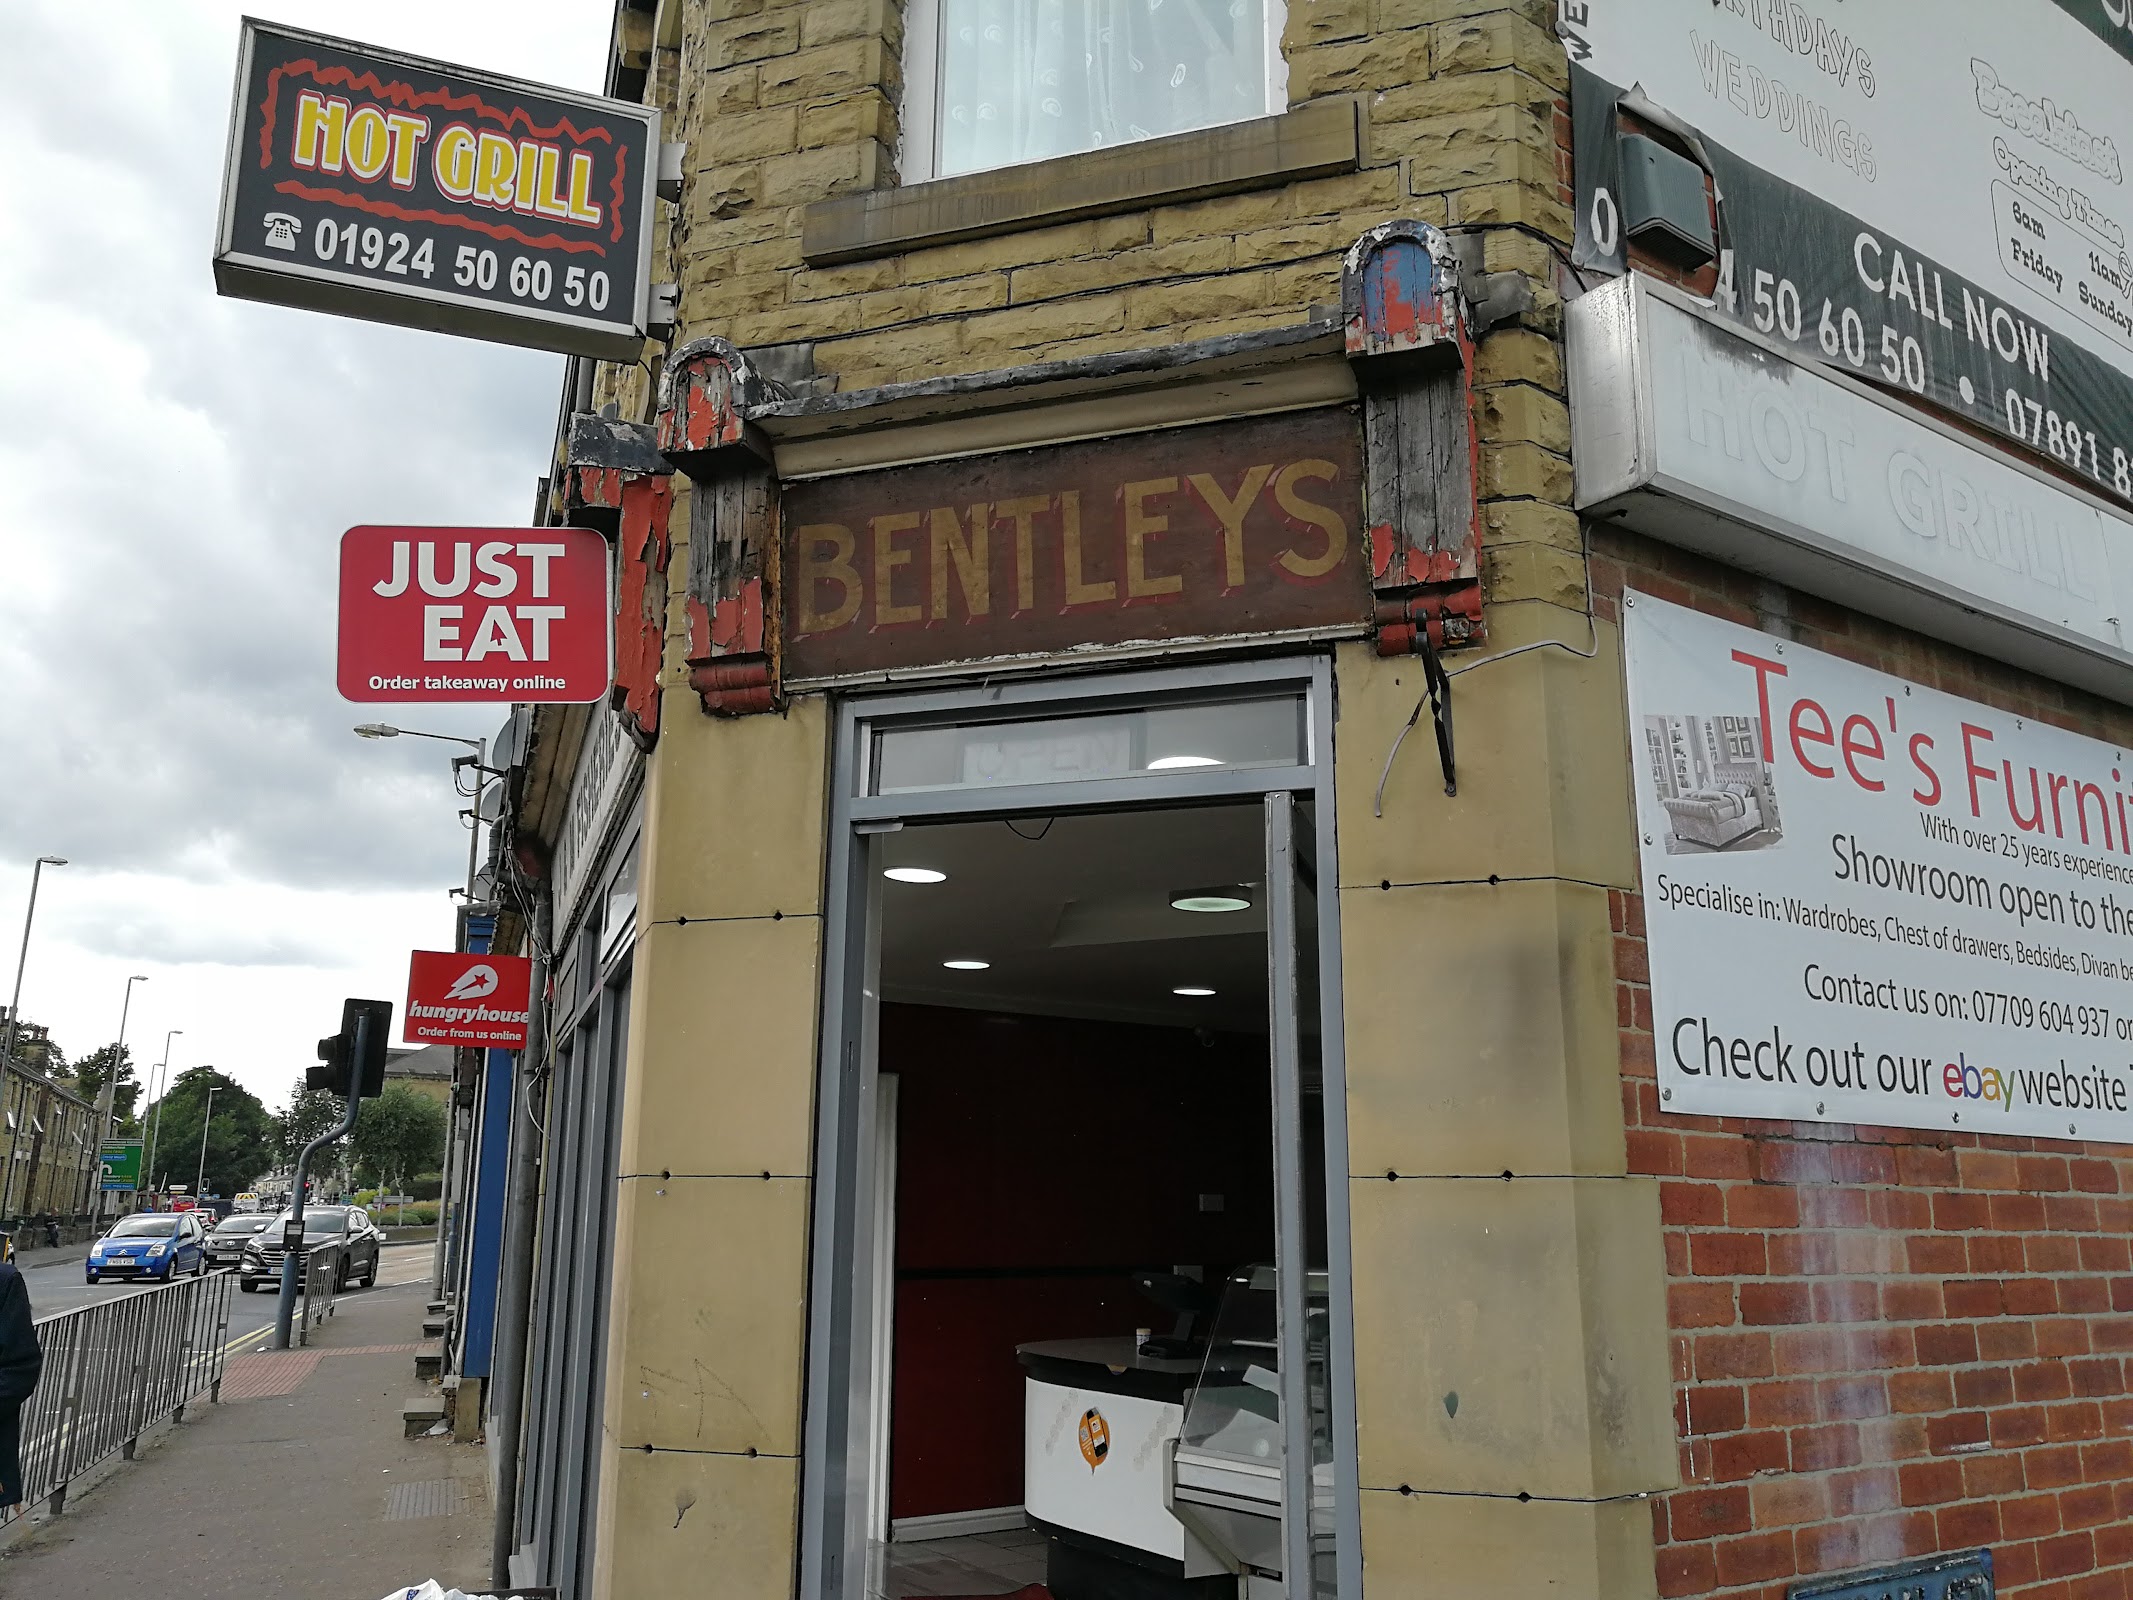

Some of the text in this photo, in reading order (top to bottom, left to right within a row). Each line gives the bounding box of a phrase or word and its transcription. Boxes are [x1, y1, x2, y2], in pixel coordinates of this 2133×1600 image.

[1689, 29, 1877, 182] WEDDINGS
[1971, 57, 2122, 185] Breakfast
[293, 92, 602, 226] HOT GRILL
[1993, 136, 2071, 219] Opening
[315, 218, 610, 312] 01924 50 60 50
[2011, 237, 2132, 337] Friday Sunday
[2012, 201, 2123, 290] 6am 11am
[1853, 232, 2049, 382] CALL NOW
[1754, 271, 2133, 497] 50 60 50 07891 8
[1680, 346, 2097, 604] HOT GRILL
[794, 459, 1348, 641] BENTLEYS
[372, 541, 566, 661] JUST EAT
[369, 675, 566, 692] Order takeaway online
[1731, 648, 2133, 856] Tee's Furni
[1832, 834, 1992, 910] Showroom
[2000, 881, 2065, 928] open
[2069, 890, 2096, 930] to
[1919, 812, 1959, 847] With
[1963, 828, 1997, 854] over
[2000, 833, 2019, 859] 25
[2021, 843, 2061, 869] years
[1657, 874, 1754, 917] Specialise
[1758, 893, 1781, 922] in:
[1784, 897, 1881, 942] Wardrobes,
[1884, 918, 1930, 949] Chest
[1933, 925, 1950, 950] of
[1952, 929, 2014, 965] drawers,
[2016, 941, 2080, 976] Bedsides,
[2081, 952, 2118, 979] Divan
[409, 1000, 529, 1024] hungryhouse
[417, 1026, 522, 1041] Order from us online
[1804, 963, 1898, 1012] Contact
[1902, 986, 1929, 1016] us
[1935, 989, 1969, 1021] on:
[1972, 991, 2034, 1029] 07709
[2039, 1000, 2074, 1034] 604
[2078, 1005, 2109, 1038] 937
[1671, 1017, 2127, 1112] Check out our ebay website
